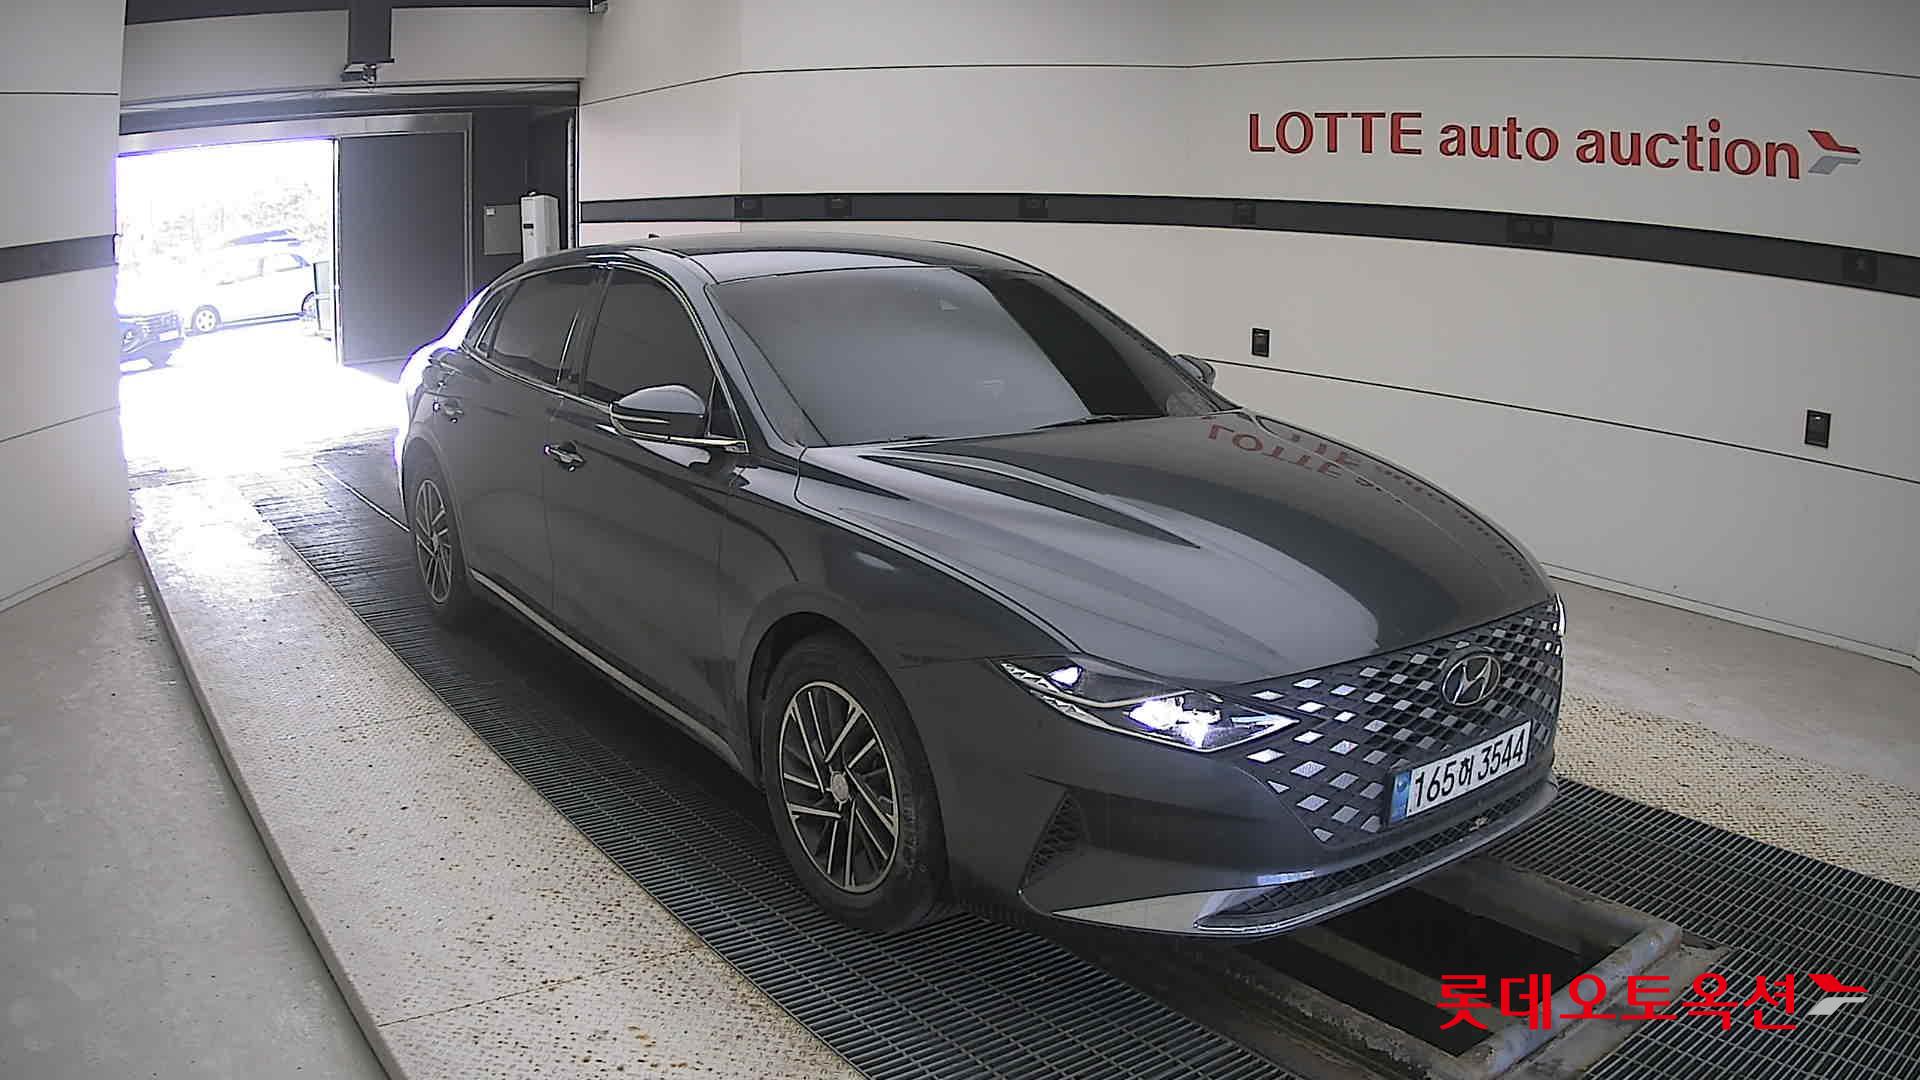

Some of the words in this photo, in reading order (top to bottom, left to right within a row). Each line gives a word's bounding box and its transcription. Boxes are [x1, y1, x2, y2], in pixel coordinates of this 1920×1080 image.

[1248, 111, 1423, 155] LOTTE
[1439, 116, 1560, 162] auto
[1575, 118, 1801, 180] auction
[1415, 755, 1474, 808] 165허
[1477, 728, 1526, 780] 3544
